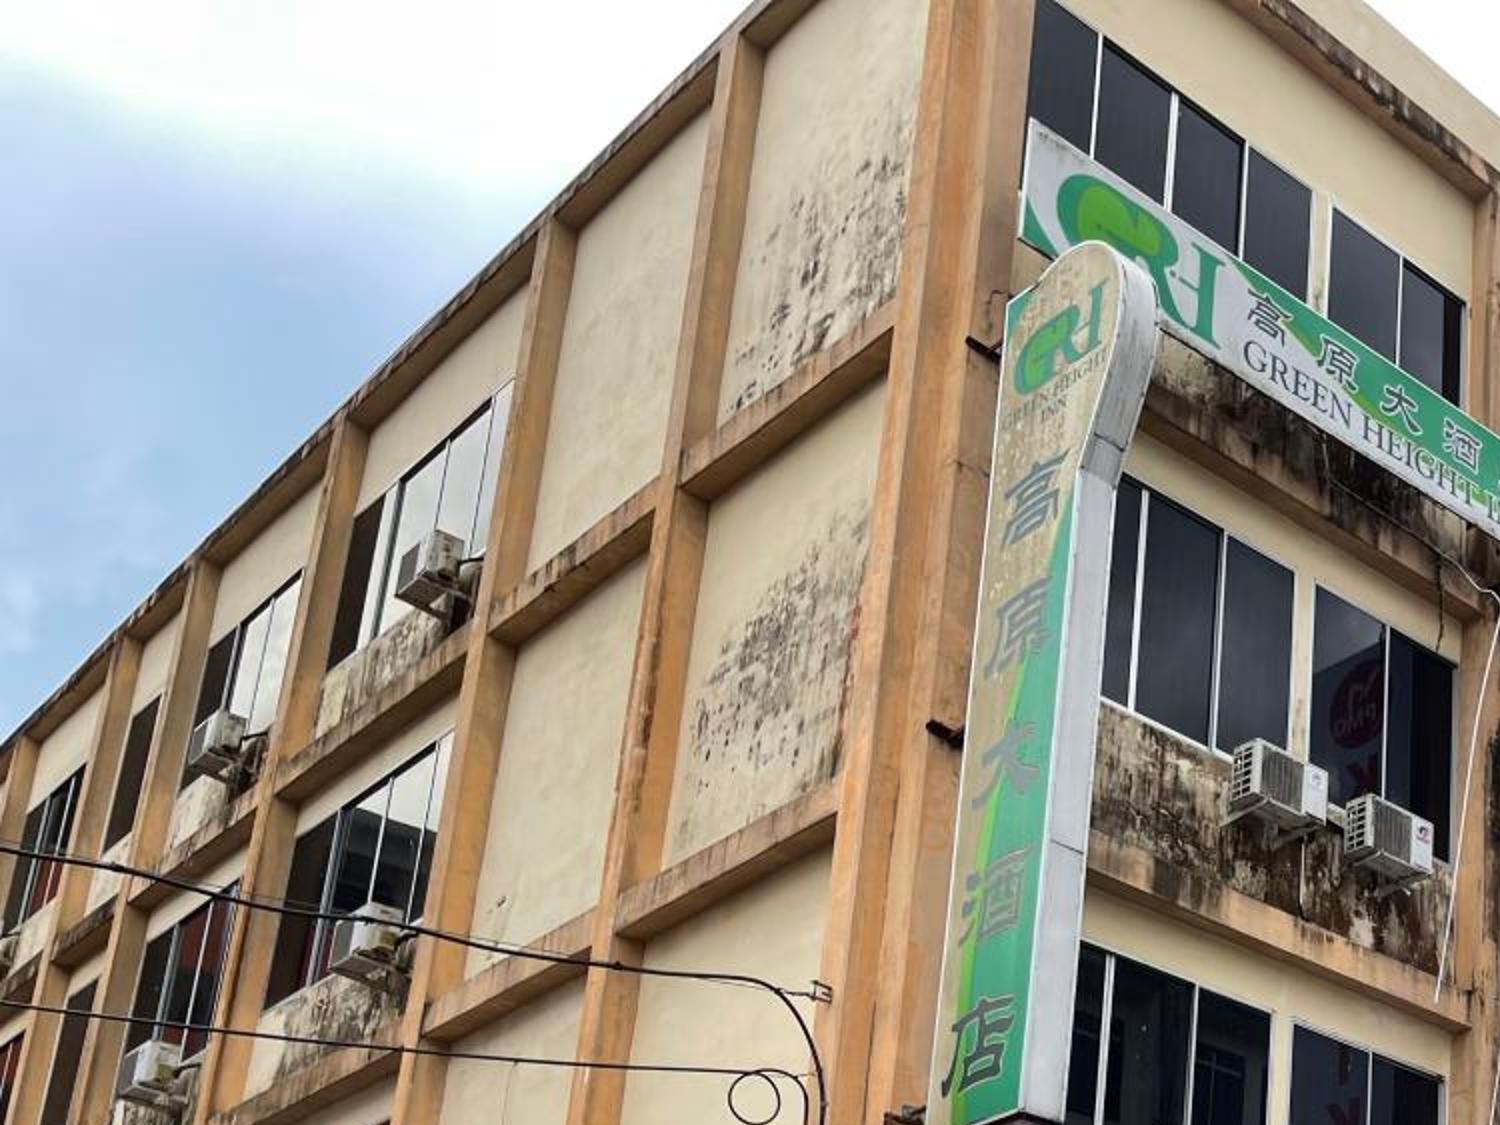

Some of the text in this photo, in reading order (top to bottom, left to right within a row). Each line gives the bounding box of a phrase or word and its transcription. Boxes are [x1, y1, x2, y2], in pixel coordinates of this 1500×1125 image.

[1243, 340, 1354, 428] GREEN
[1362, 416, 1478, 505] HEIGHT
[942, 446, 1071, 1099] 高原大酒店
